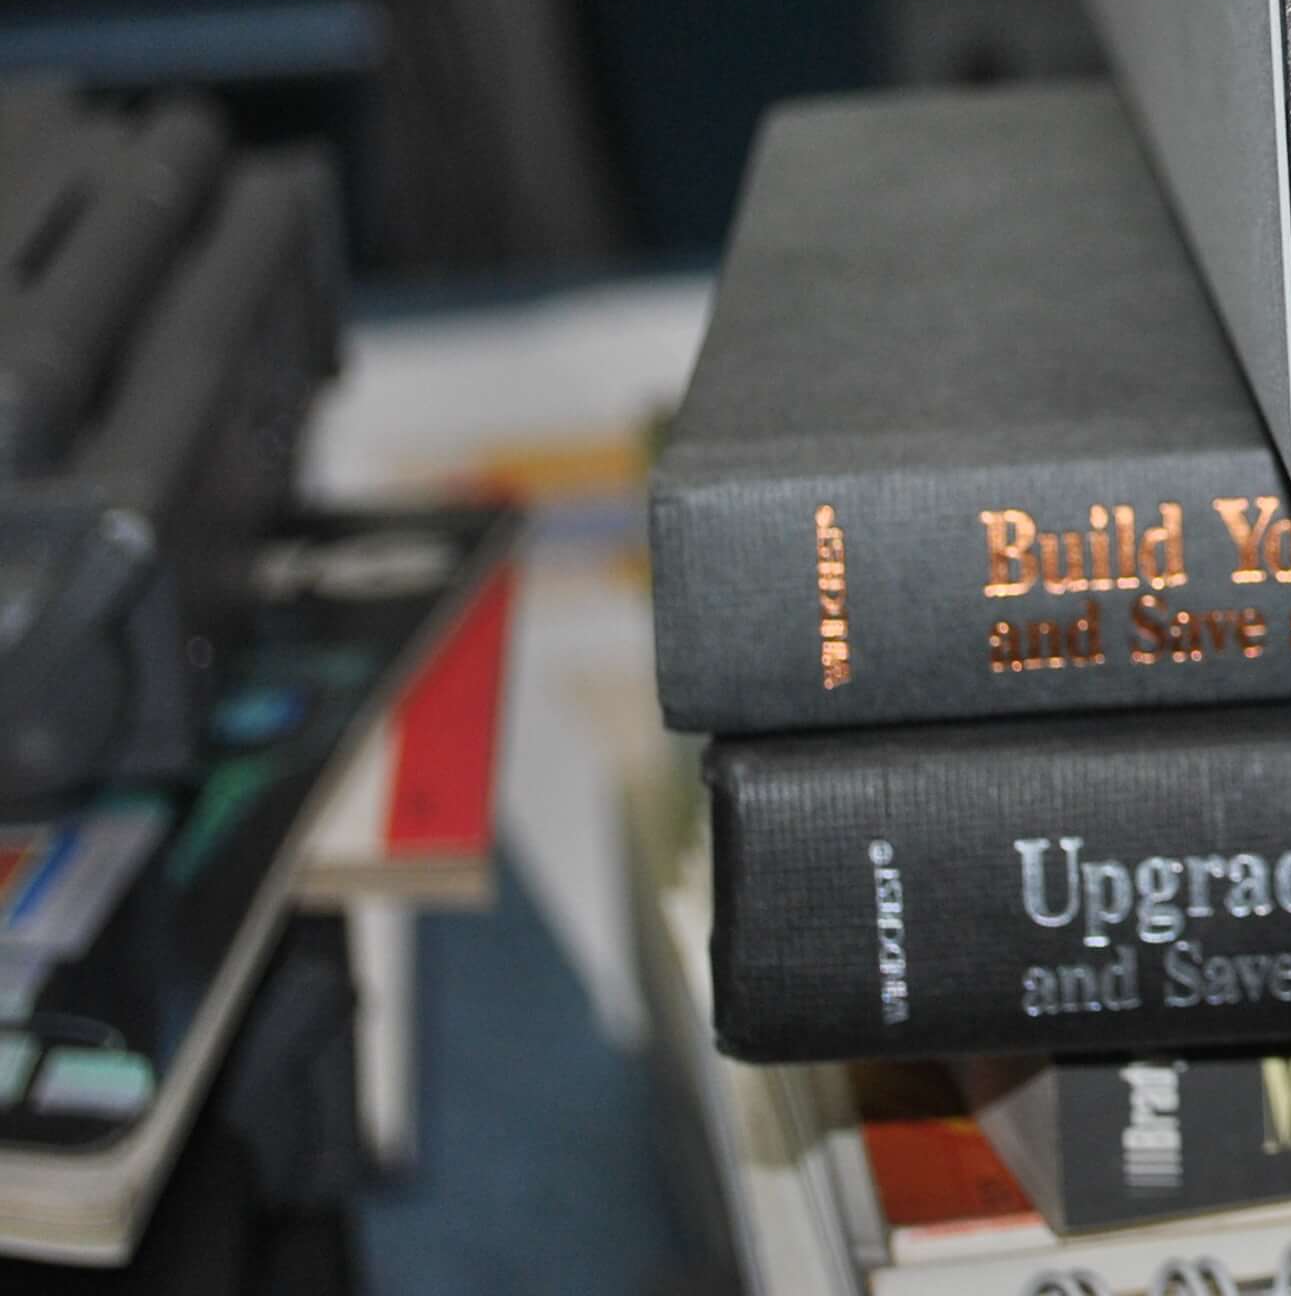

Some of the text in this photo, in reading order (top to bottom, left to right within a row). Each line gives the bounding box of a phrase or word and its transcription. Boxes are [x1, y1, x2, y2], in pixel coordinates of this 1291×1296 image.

[980, 501, 1189, 597] Build
[989, 600, 1105, 674] and
[1129, 593, 1267, 664] Save
[1021, 942, 1140, 1017] and
